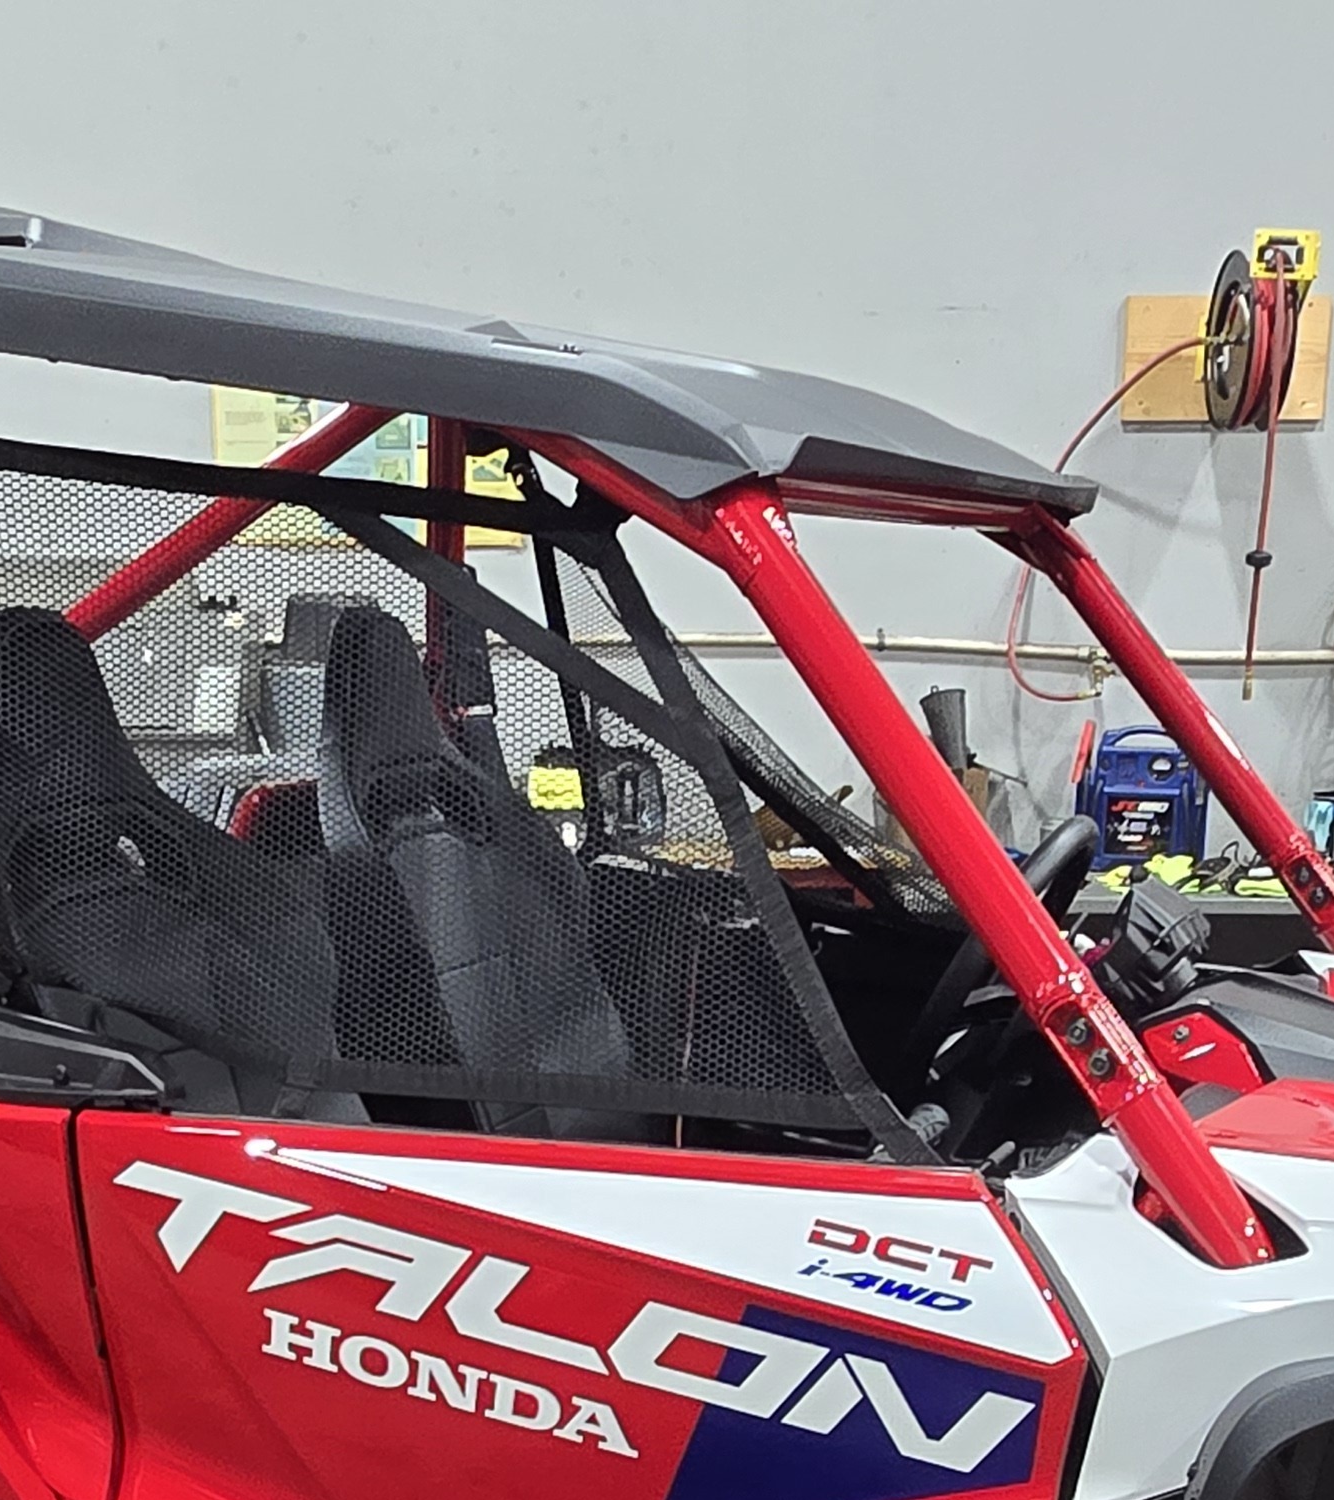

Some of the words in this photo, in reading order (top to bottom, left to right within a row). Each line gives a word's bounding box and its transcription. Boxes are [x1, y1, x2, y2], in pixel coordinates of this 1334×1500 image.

[797, 1258, 973, 1311] i-4WD
[807, 1218, 994, 1283] DCT
[113, 1160, 1036, 1473] TALON
[261, 1308, 638, 1458] HONDA
